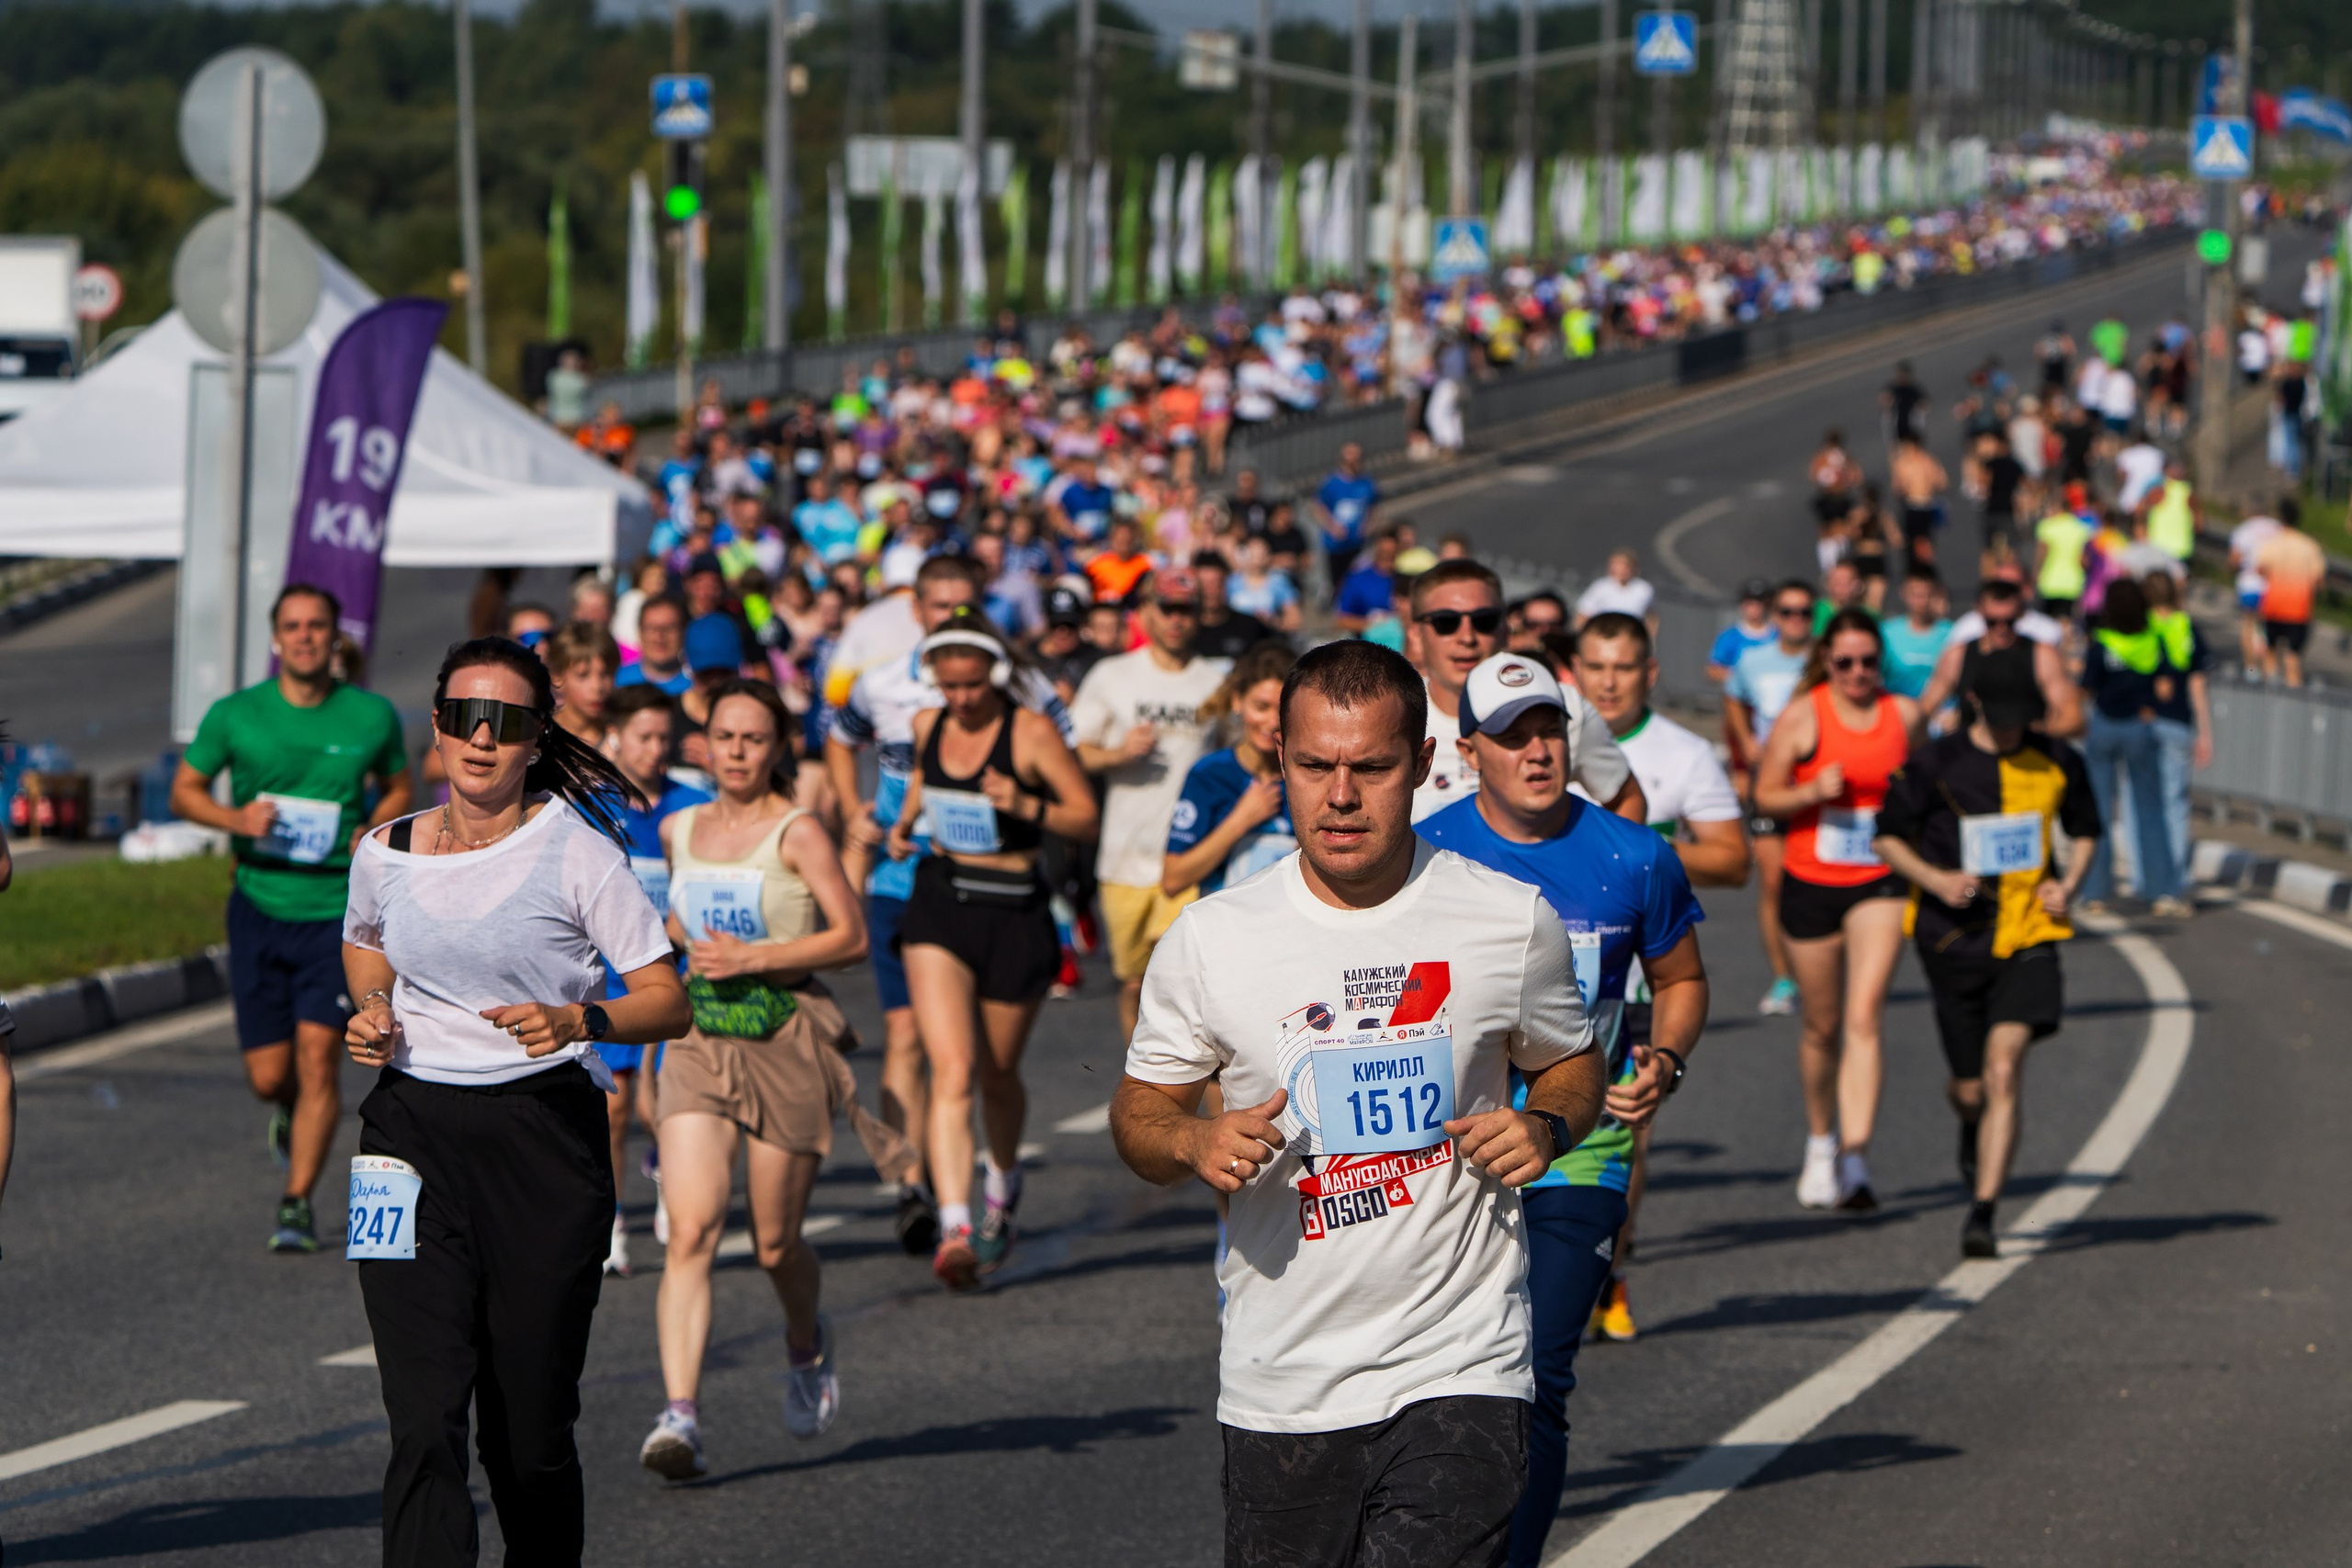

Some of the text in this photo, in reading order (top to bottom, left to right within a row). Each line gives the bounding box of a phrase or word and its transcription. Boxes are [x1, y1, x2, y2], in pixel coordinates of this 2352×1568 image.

[324, 415, 399, 493] 19
[702, 907, 757, 936] 1646
[1344, 964, 1407, 982] КАЛУЖСКИЙ
[1344, 976, 1422, 997] КОСМИЧЕСКИЙ
[1345, 994, 1404, 1011] МАРАФОН
[1408, 1027, 1425, 1038] Пэй
[1352, 1055, 1425, 1083] КИРИЛЛ
[1346, 1082, 1442, 1137] 1512
[1319, 1141, 1452, 1196] МАНУФАКТУРЫ
[1300, 1186, 1389, 1241] BOSCO
